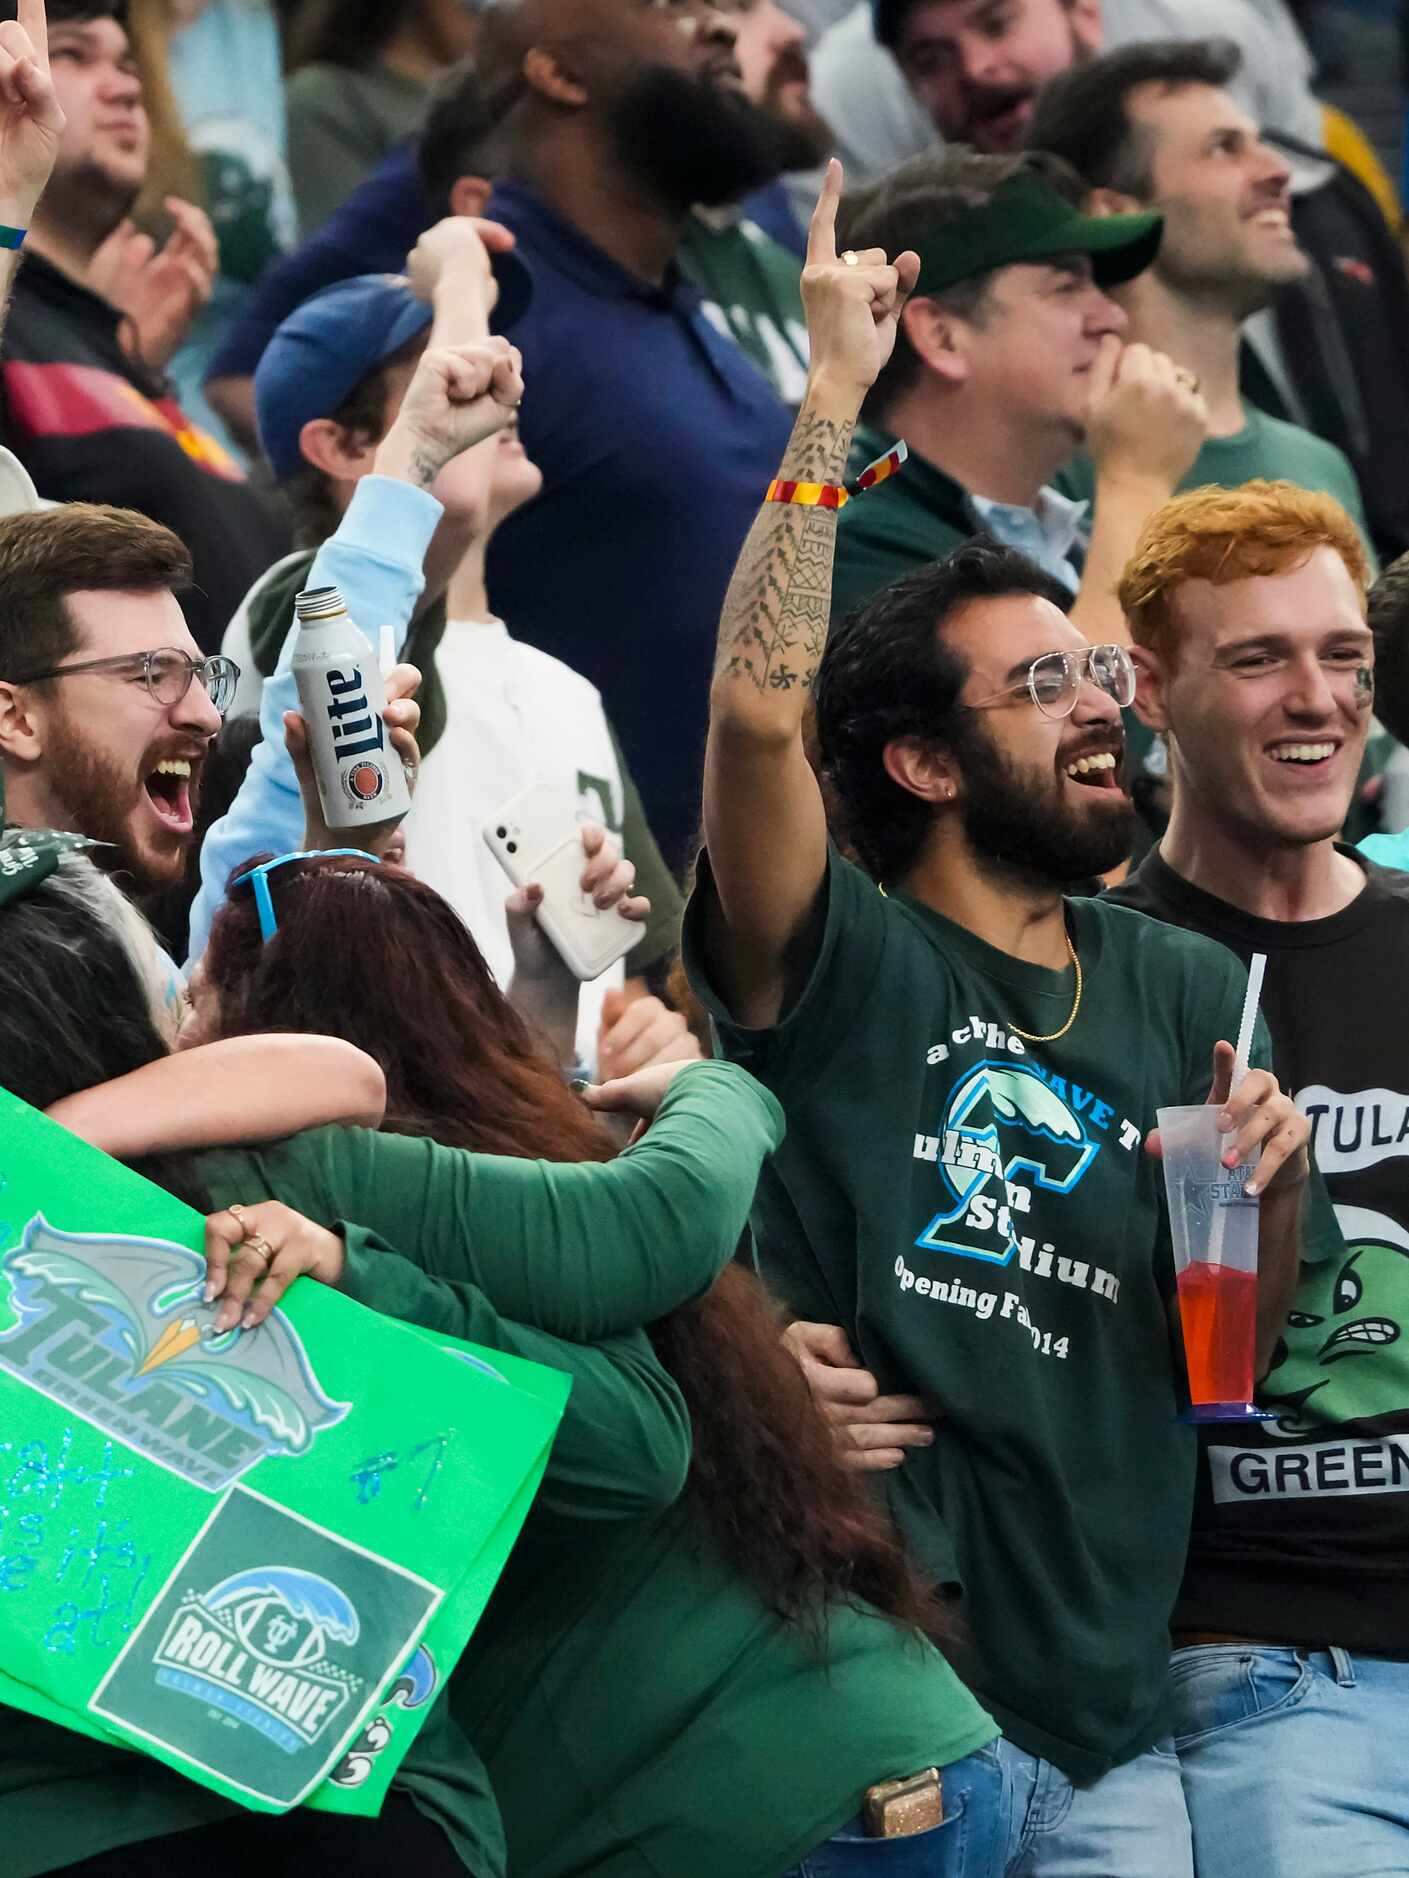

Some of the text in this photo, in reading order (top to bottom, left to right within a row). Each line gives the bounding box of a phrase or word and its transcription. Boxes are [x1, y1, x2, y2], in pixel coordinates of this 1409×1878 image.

[326, 668, 384, 764] Lite
[894, 1255, 998, 1320] Opening
[164, 1614, 249, 1686] ROLL
[247, 1664, 339, 1734] WAVE
